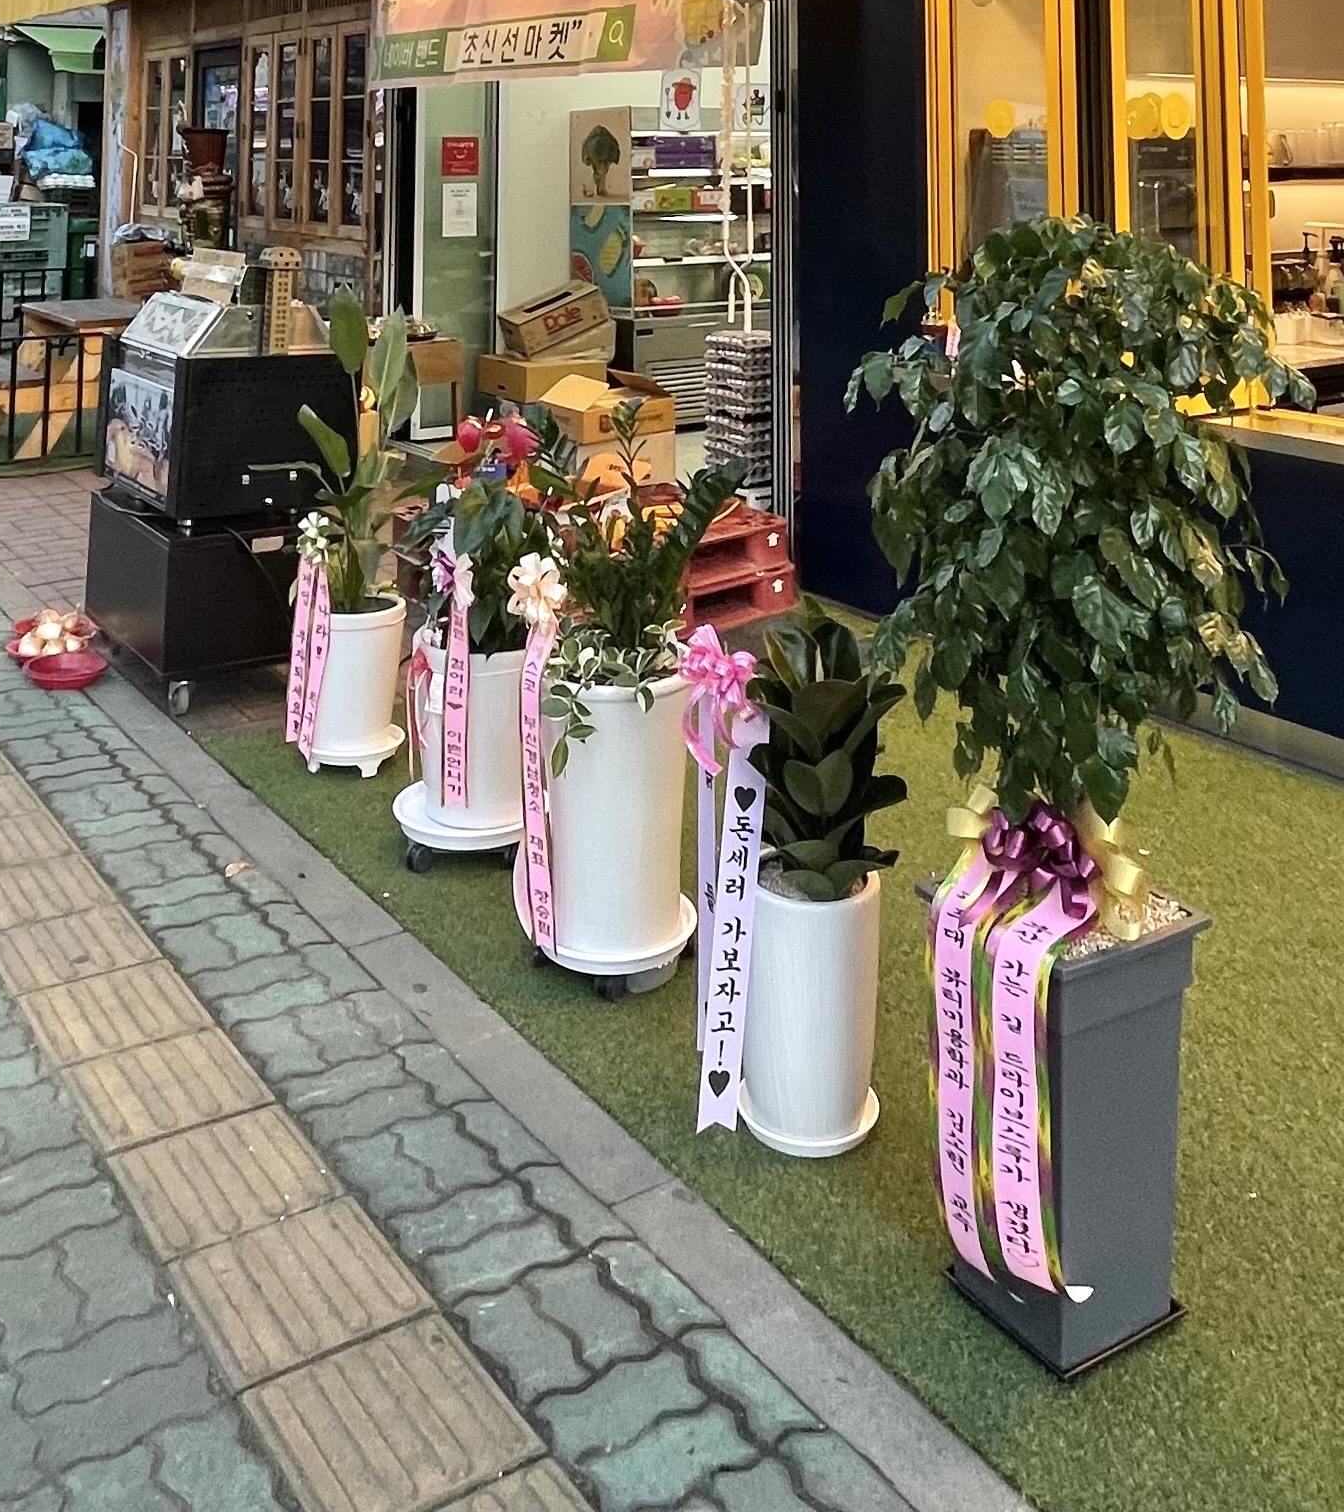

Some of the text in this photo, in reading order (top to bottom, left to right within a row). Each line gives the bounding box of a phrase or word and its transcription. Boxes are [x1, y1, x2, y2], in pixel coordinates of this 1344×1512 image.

[542, 304, 583, 334] Dole
[725, 814, 755, 902] 돈세러
[711, 916, 747, 1067] 가보자고!
